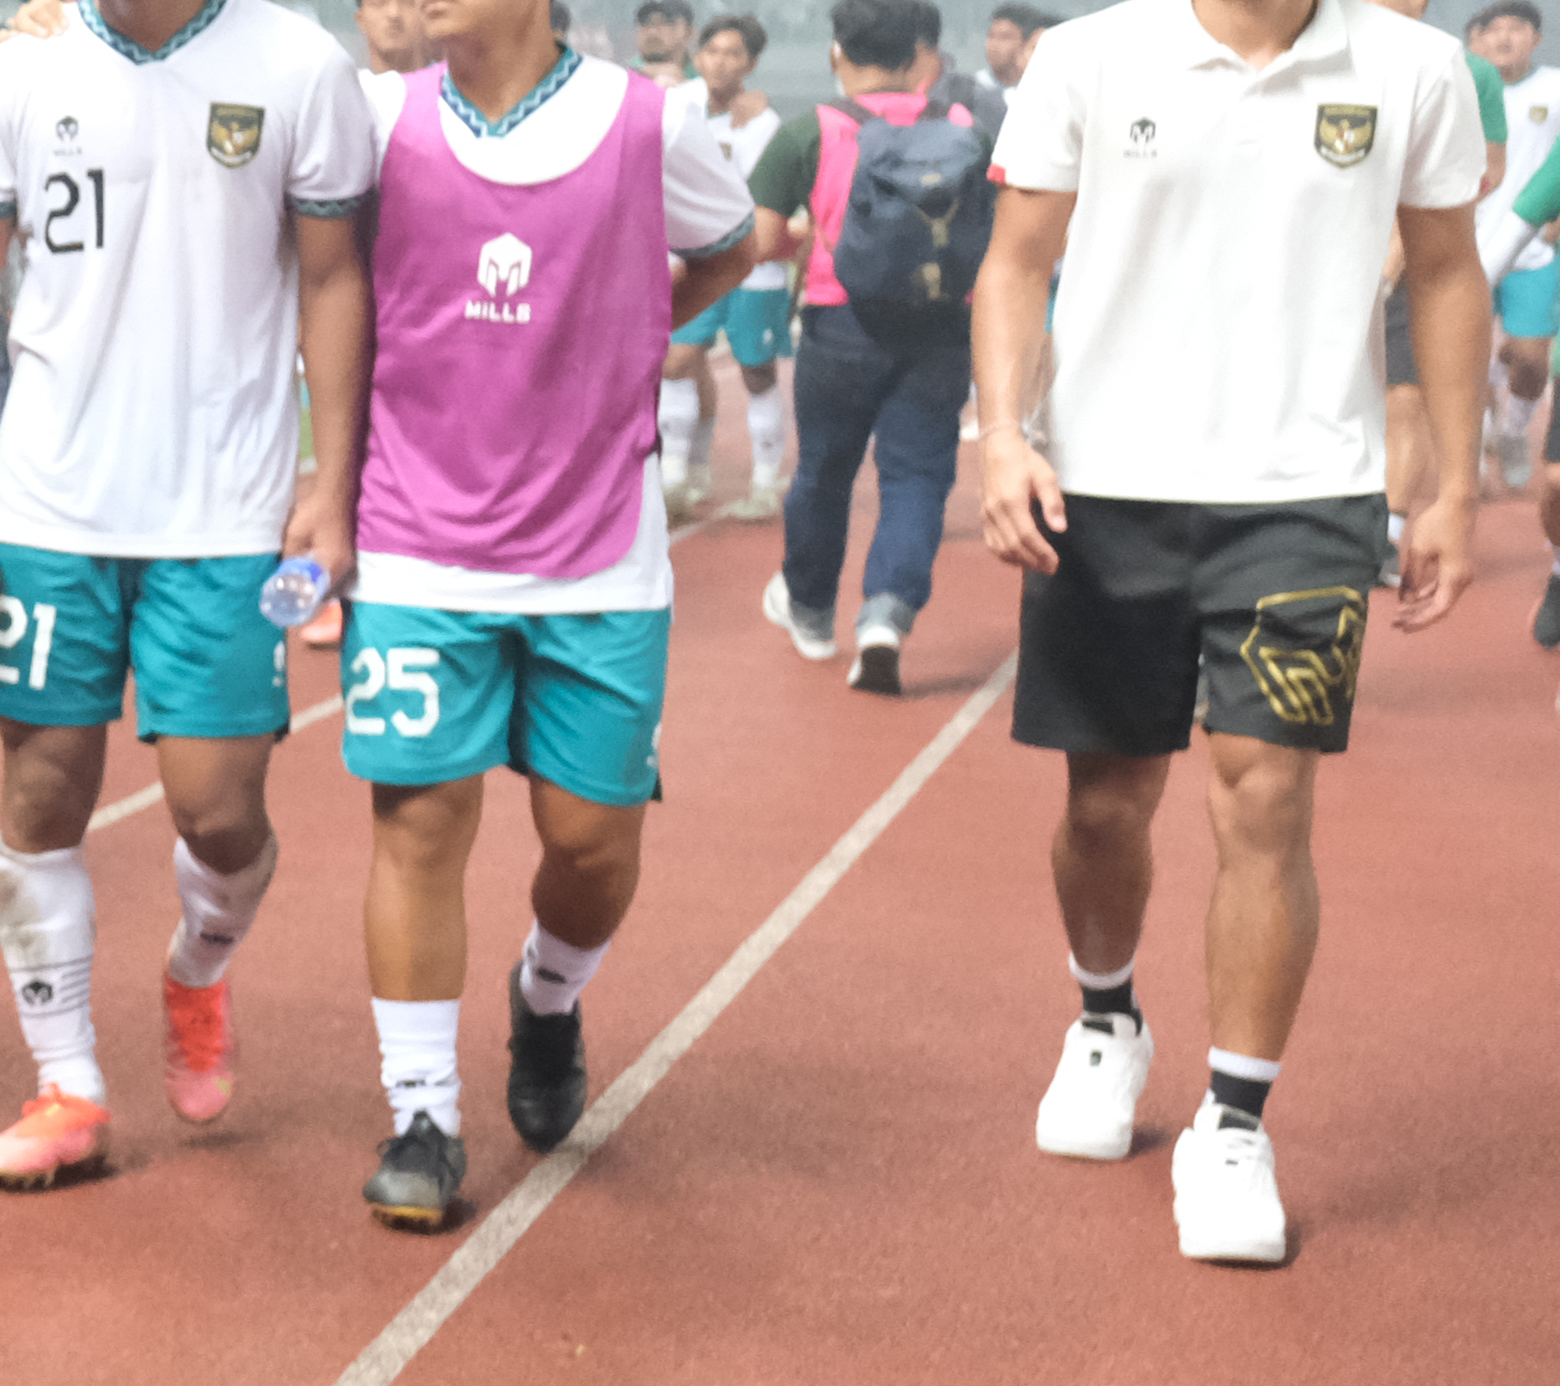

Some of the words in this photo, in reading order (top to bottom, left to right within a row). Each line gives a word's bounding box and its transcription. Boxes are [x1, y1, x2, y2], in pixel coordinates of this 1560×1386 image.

[43, 167, 105, 254] 21
[464, 299, 531, 324] MILLS
[346, 646, 440, 737] 25
